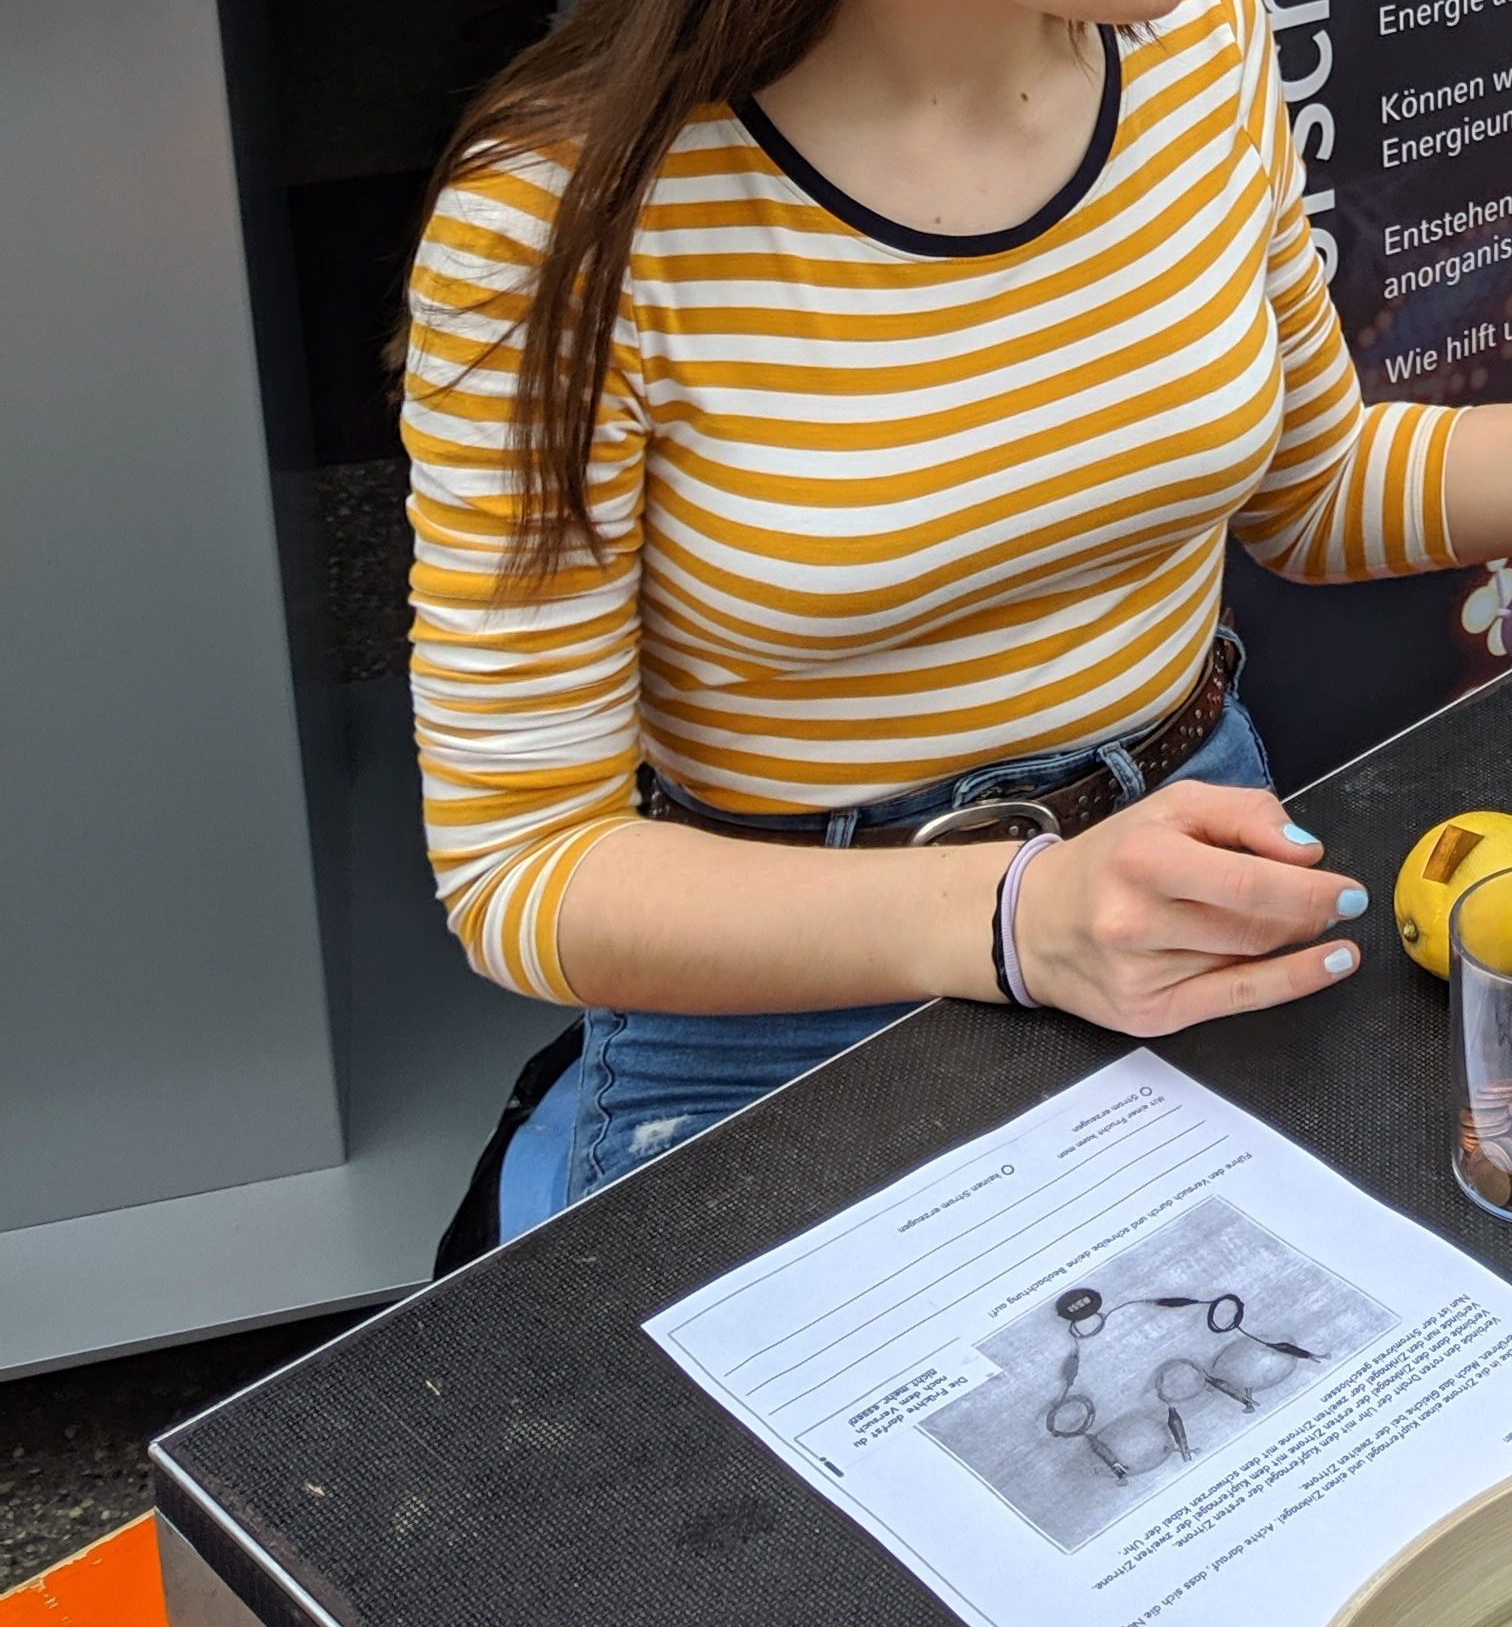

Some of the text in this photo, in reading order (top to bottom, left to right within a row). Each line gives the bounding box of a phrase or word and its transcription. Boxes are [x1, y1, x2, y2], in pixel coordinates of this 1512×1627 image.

[1381, 77, 1483, 123] Können
[1384, 195, 1512, 255] Entstehen
[1385, 347, 1437, 383] Wie
[1447, 322, 1496, 362] hilft
[1172, 1316, 1501, 1547] Verbinde den roten Draht der Uhr mit dem Kupfernagel der ersten Zitrone.
